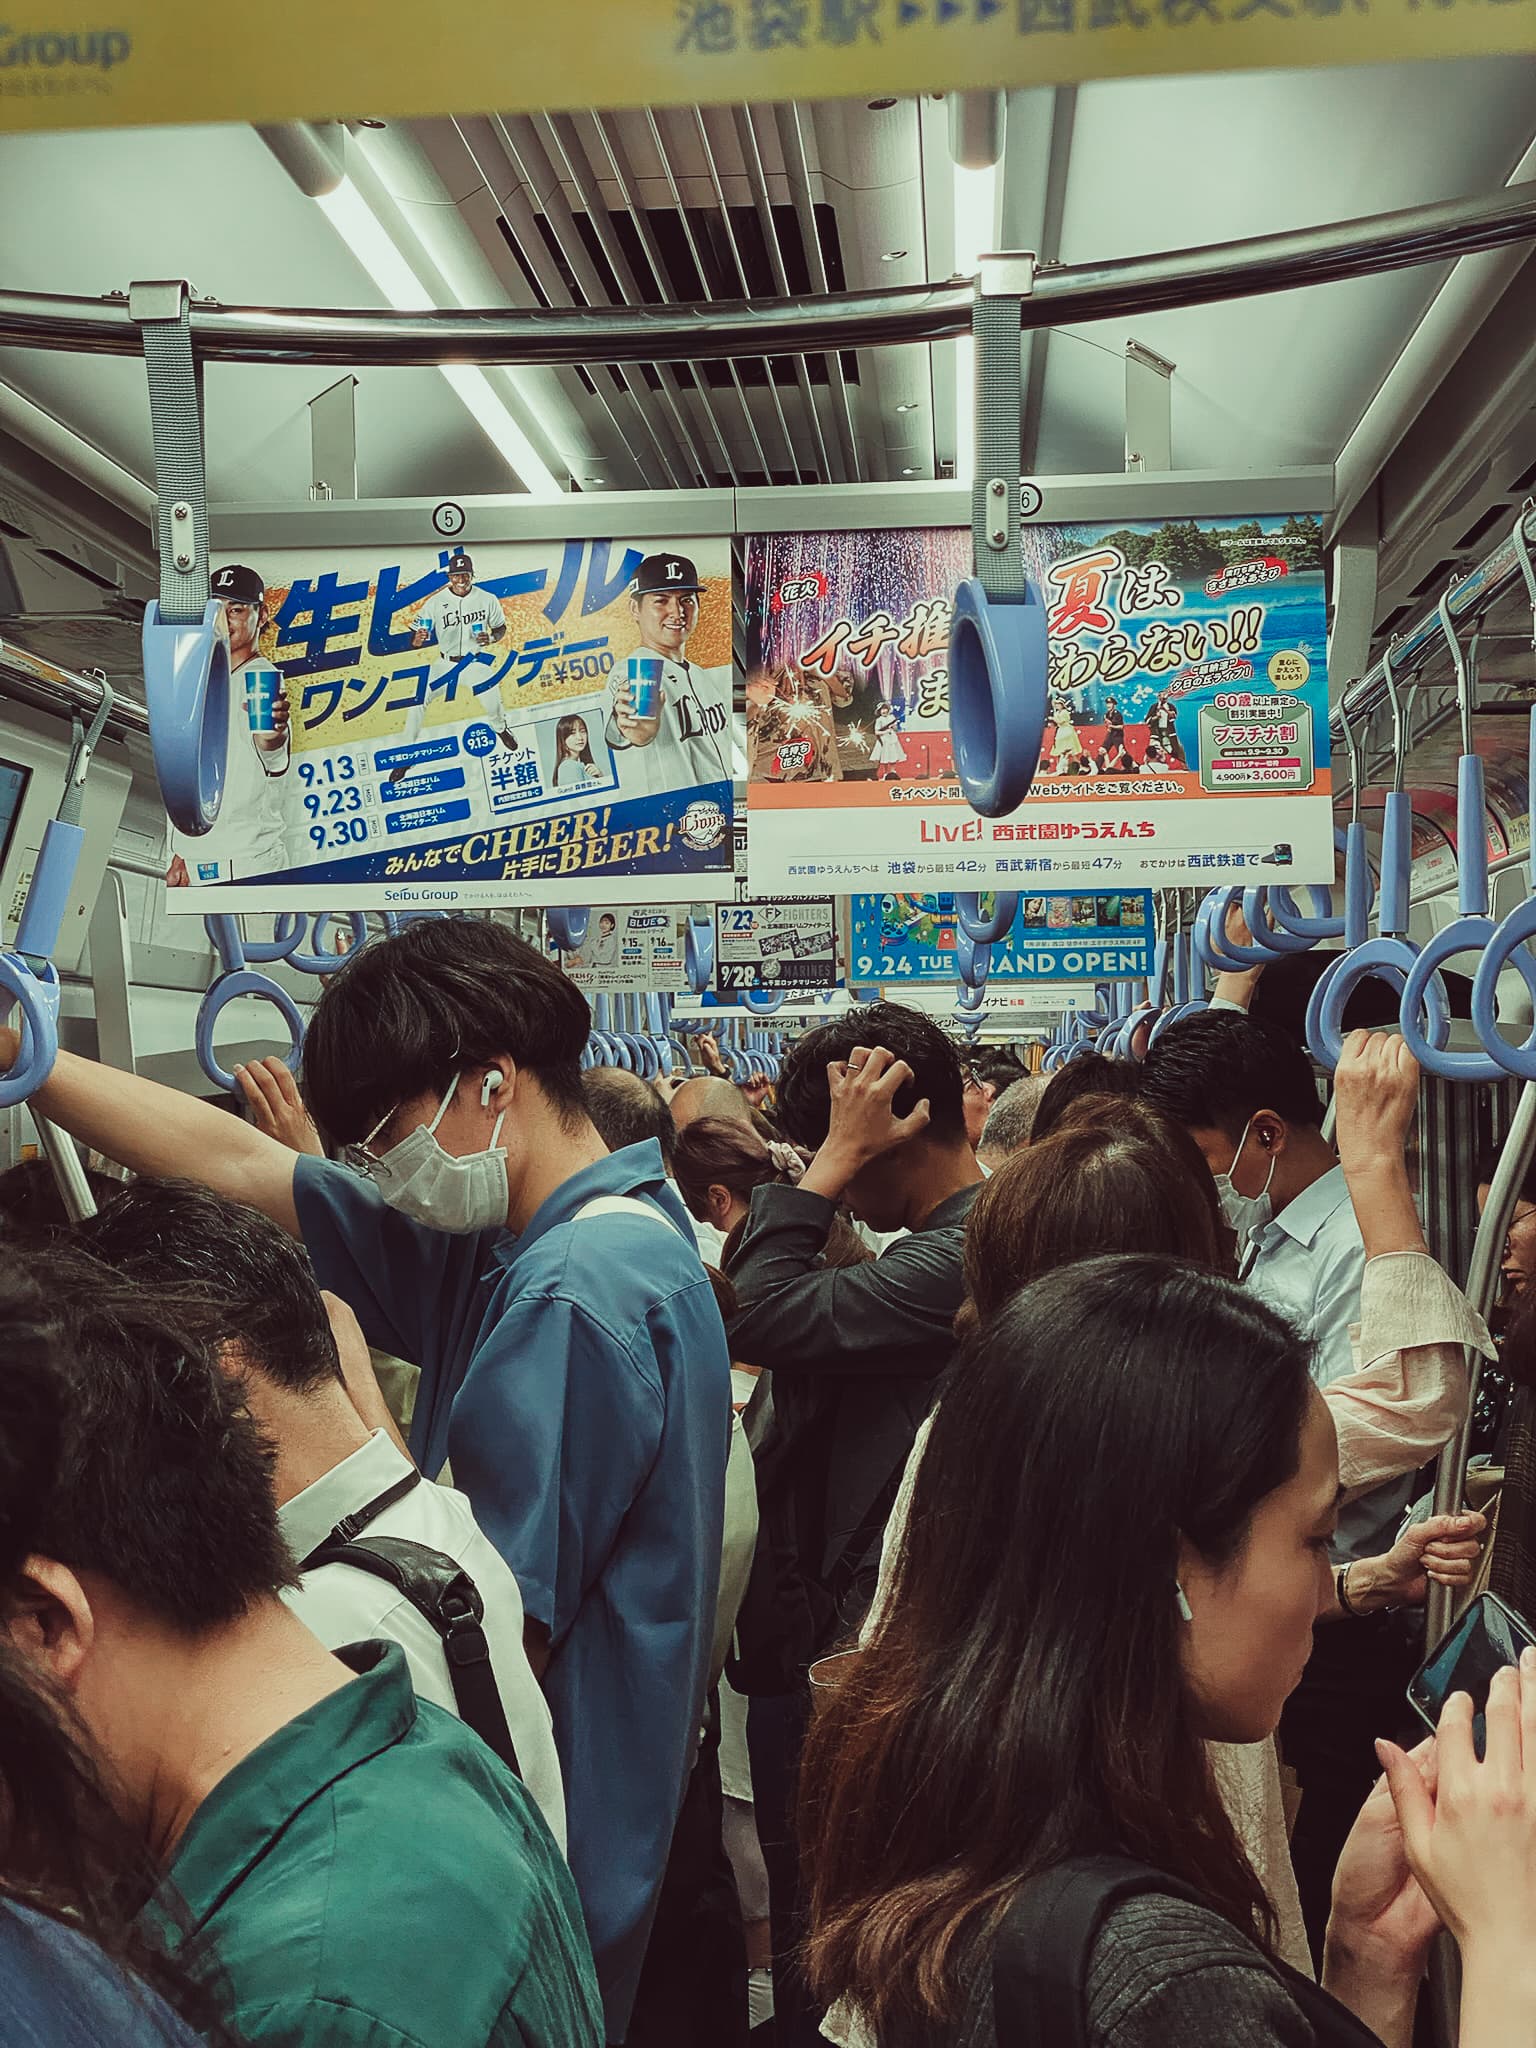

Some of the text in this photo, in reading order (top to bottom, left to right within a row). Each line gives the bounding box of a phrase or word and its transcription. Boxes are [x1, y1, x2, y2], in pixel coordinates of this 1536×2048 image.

[1022, 491, 1030, 508] 6
[445, 510, 454, 527] 5
[217, 569, 234, 587] L
[665, 562, 684, 581] L
[781, 581, 818, 601] 花火
[1048, 607, 1262, 690] わらない!!
[552, 652, 615, 684] ¥500
[303, 632, 609, 731] ワンコインデー
[1215, 726, 1295, 742] プラチナ割
[489, 747, 536, 768] チケット
[298, 755, 355, 788] 9.13
[490, 761, 539, 791] 半額
[1252, 769, 1296, 780] 3,600円
[303, 786, 362, 819] 9.23
[309, 817, 368, 850] 9.30
[992, 821, 1156, 841] 西武園ゆうえんち
[384, 888, 458, 901] Seibu Group
[629, 918, 656, 927] BLUE
[721, 909, 754, 930] 9/23
[783, 908, 829, 921] FIGHTERS
[857, 956, 913, 975] 9.24
[919, 956, 952, 969] TUE
[1062, 951, 1147, 973] OPEN!
[721, 965, 756, 987] 9/28
